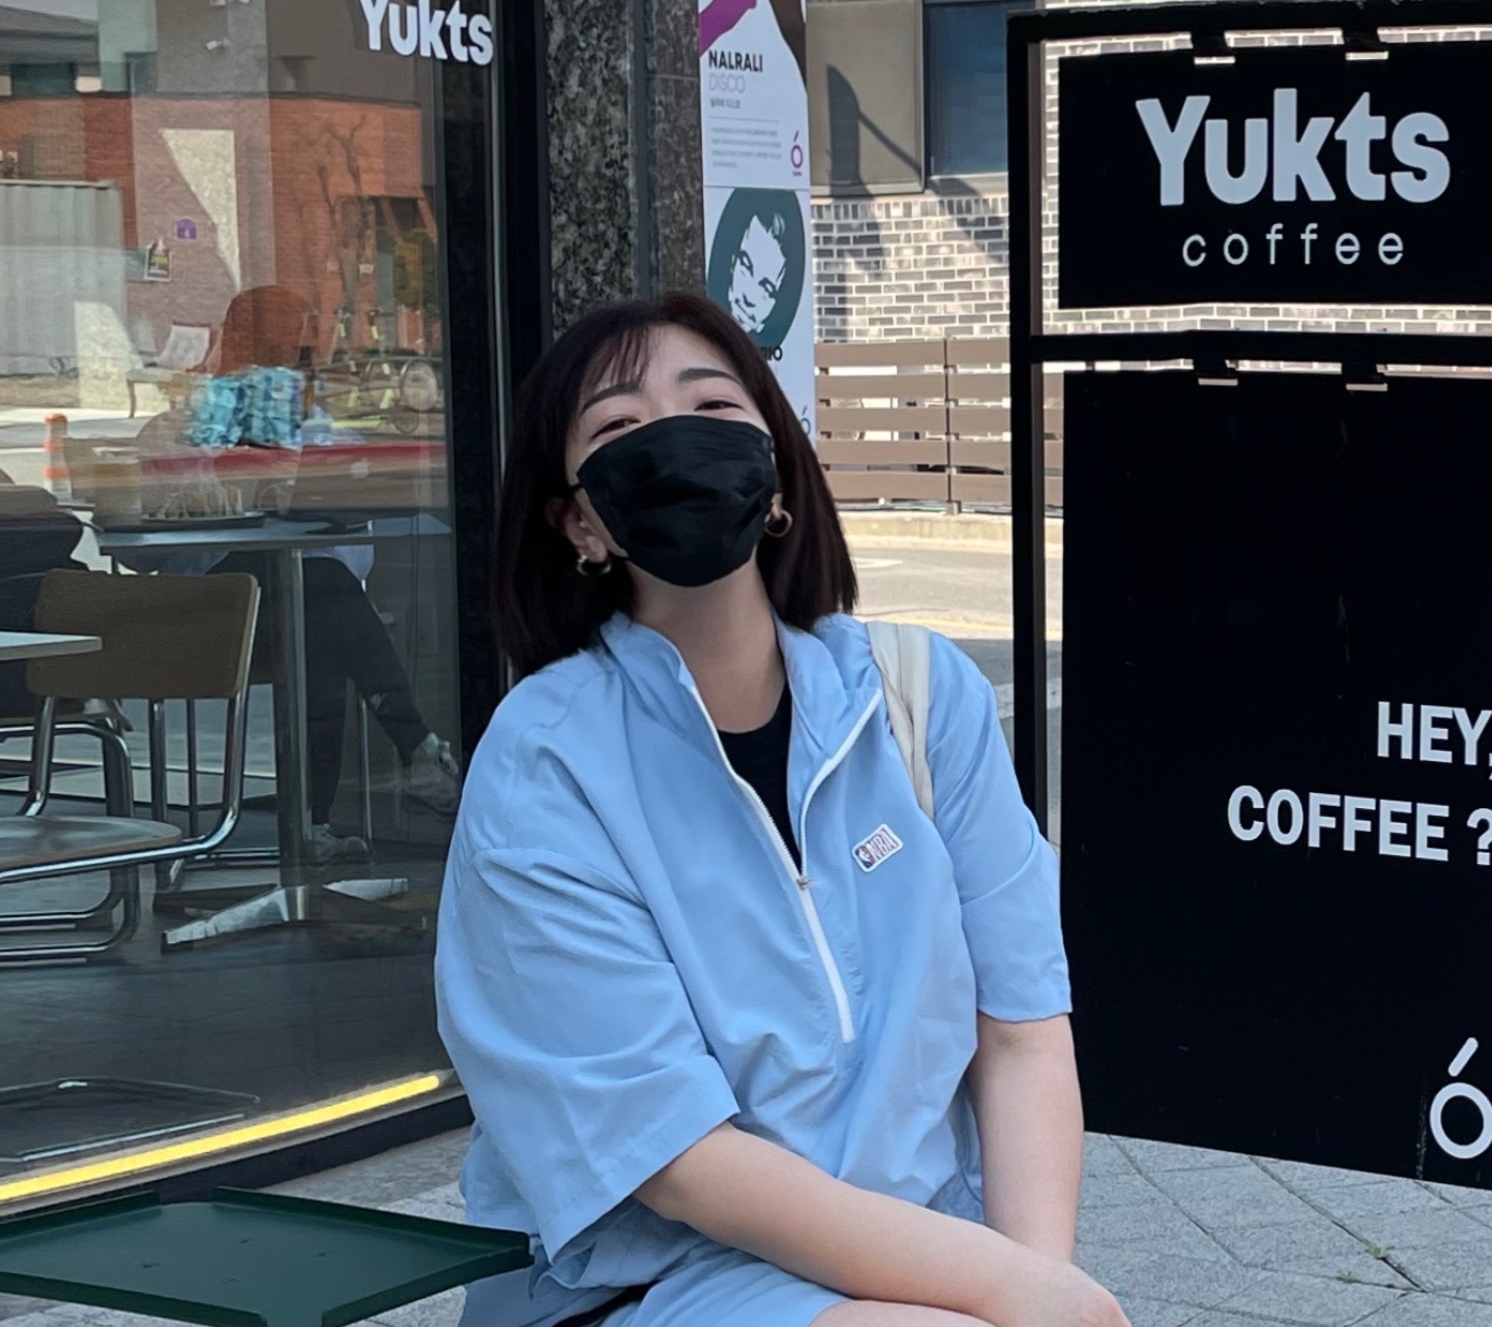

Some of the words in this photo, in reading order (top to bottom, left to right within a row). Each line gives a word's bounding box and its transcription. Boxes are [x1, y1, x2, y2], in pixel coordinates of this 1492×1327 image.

[708, 50, 764, 73] NALRALI
[709, 73, 746, 94] DISCO
[1136, 87, 1451, 207] Yukts
[1181, 222, 1405, 268] coffee
[1226, 784, 1451, 863] COFFEE
[866, 830, 899, 862] NBA
